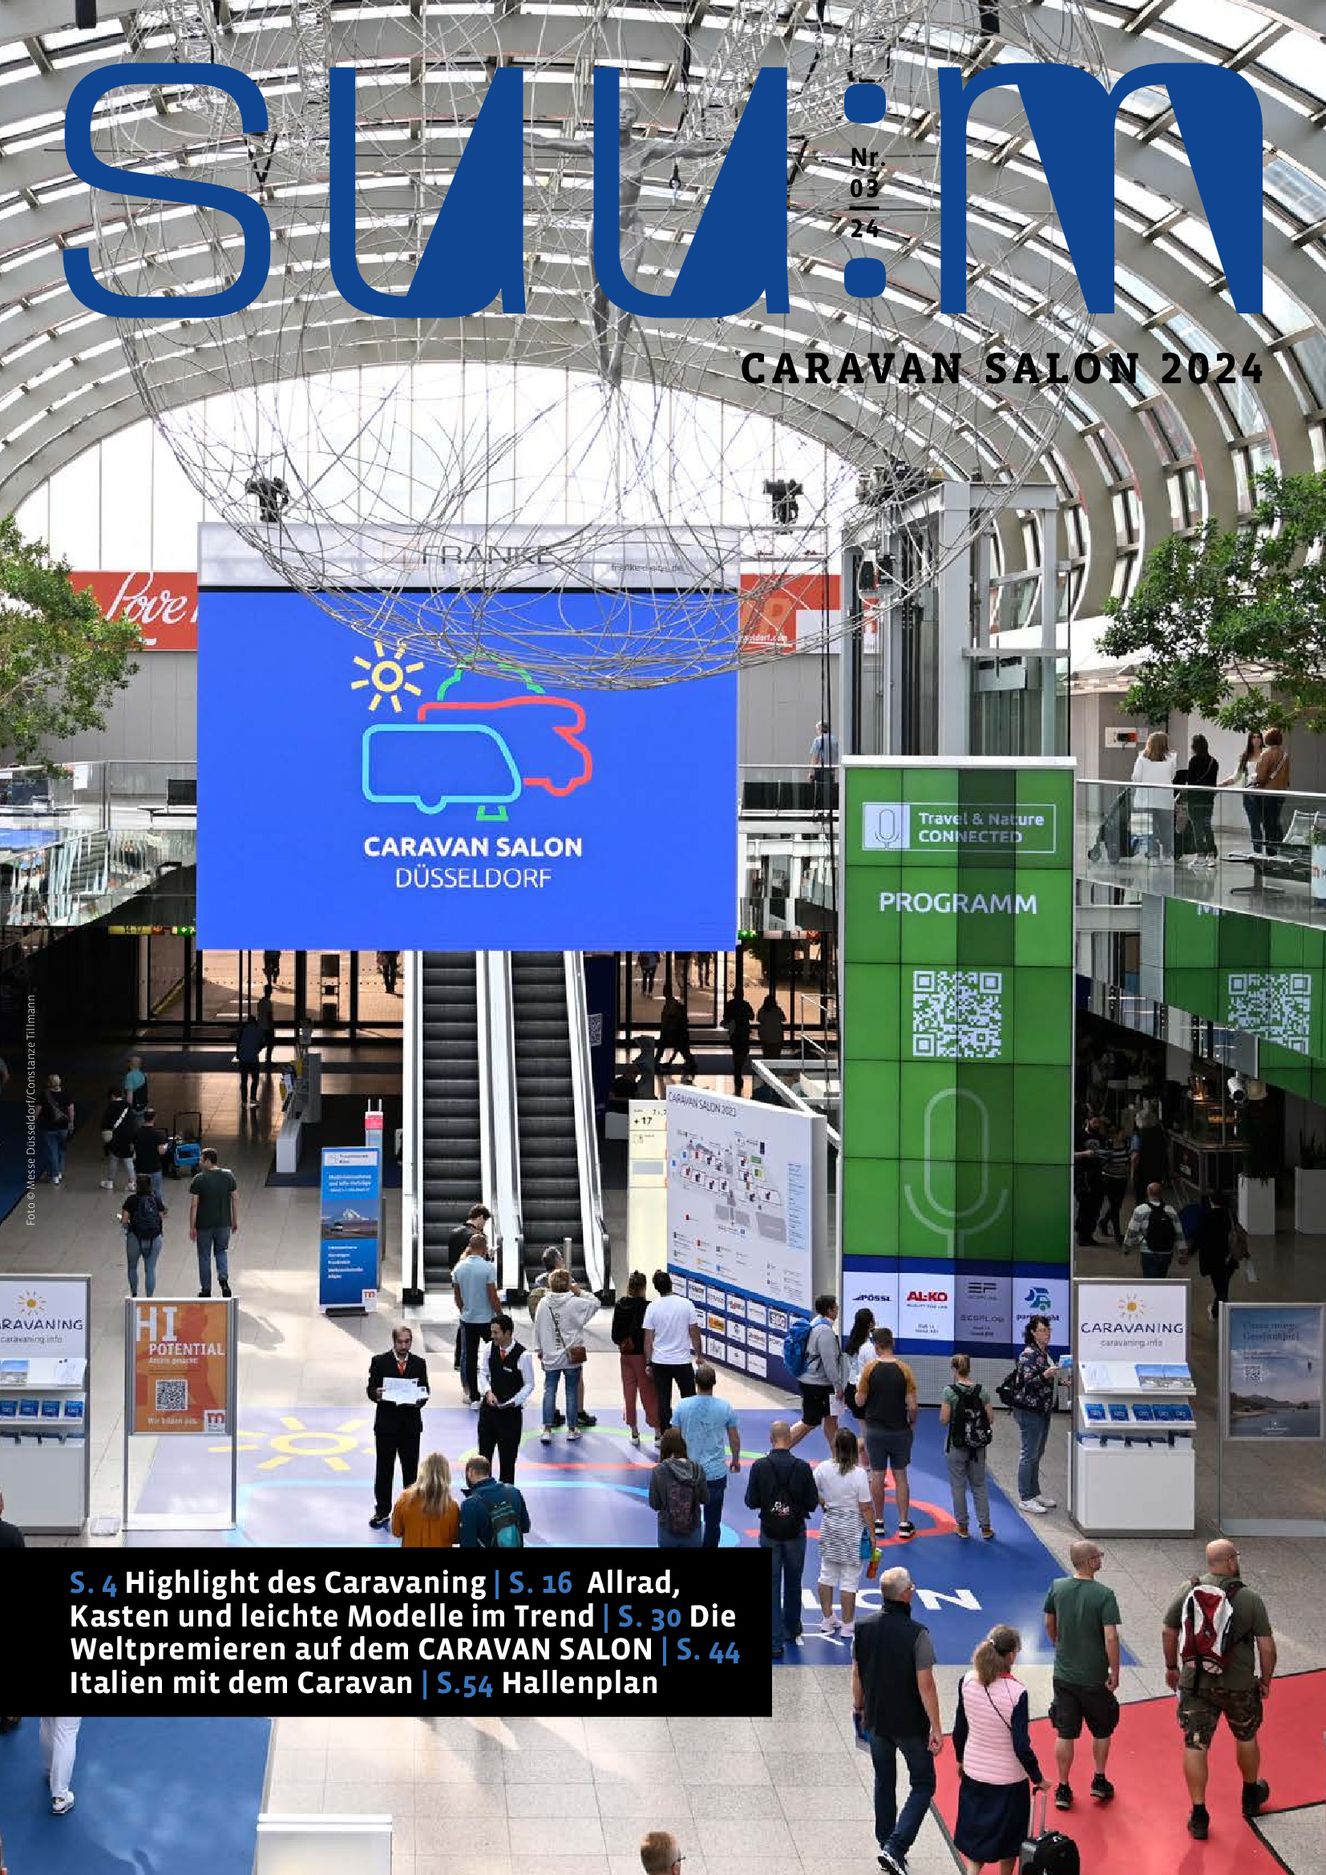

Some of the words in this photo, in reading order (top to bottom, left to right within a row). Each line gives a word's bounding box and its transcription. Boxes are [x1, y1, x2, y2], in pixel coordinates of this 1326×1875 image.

[918, 812, 968, 826] Travel
[972, 812, 985, 826] &
[989, 813, 1045, 827] Nature
[918, 829, 1023, 844] CONNECTED
[364, 836, 489, 857] CARAVAN
[496, 836, 583, 857] SALON
[395, 863, 553, 889] DÜSSELDORF
[879, 891, 1038, 915] PROGRAMM
[668, 1091, 698, 1108] CARAVAN
[699, 1099, 721, 1113] SALON
[0, 1318, 84, 1331] RAVANING
[136, 1306, 178, 1342] HI
[1081, 1322, 1184, 1334] CARAVANING
[0, 1335, 63, 1344] caravaning.info
[1101, 1339, 1163, 1348] caravaning.info
[149, 1343, 225, 1356] POTENTIAL
